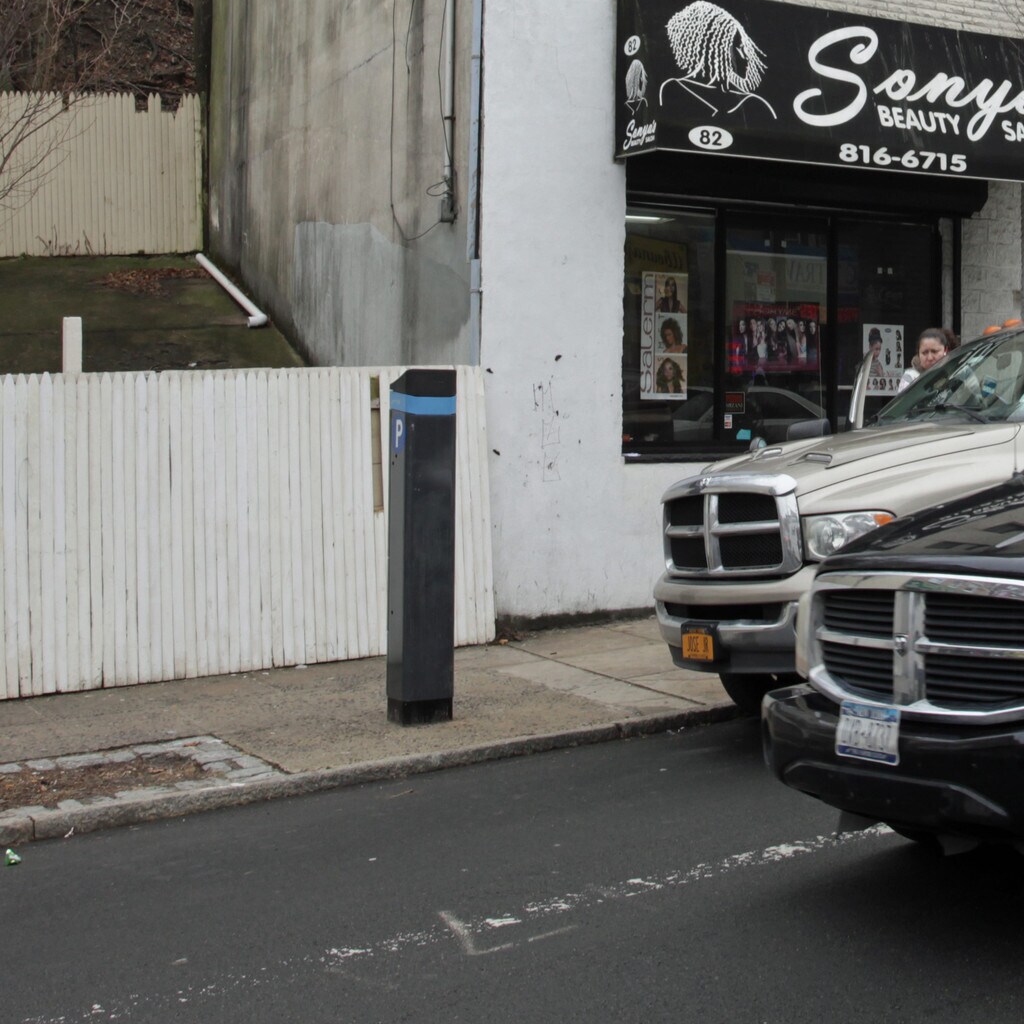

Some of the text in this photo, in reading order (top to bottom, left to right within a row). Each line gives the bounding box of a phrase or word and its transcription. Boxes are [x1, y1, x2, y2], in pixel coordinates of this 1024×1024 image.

[628, 38, 637, 52] 82
[877, 105, 960, 136] BEAUTY
[699, 129, 722, 146] 82
[839, 143, 967, 172] 816-6715
[396, 419, 403, 449] P
[687, 635, 700, 653] JOSE
